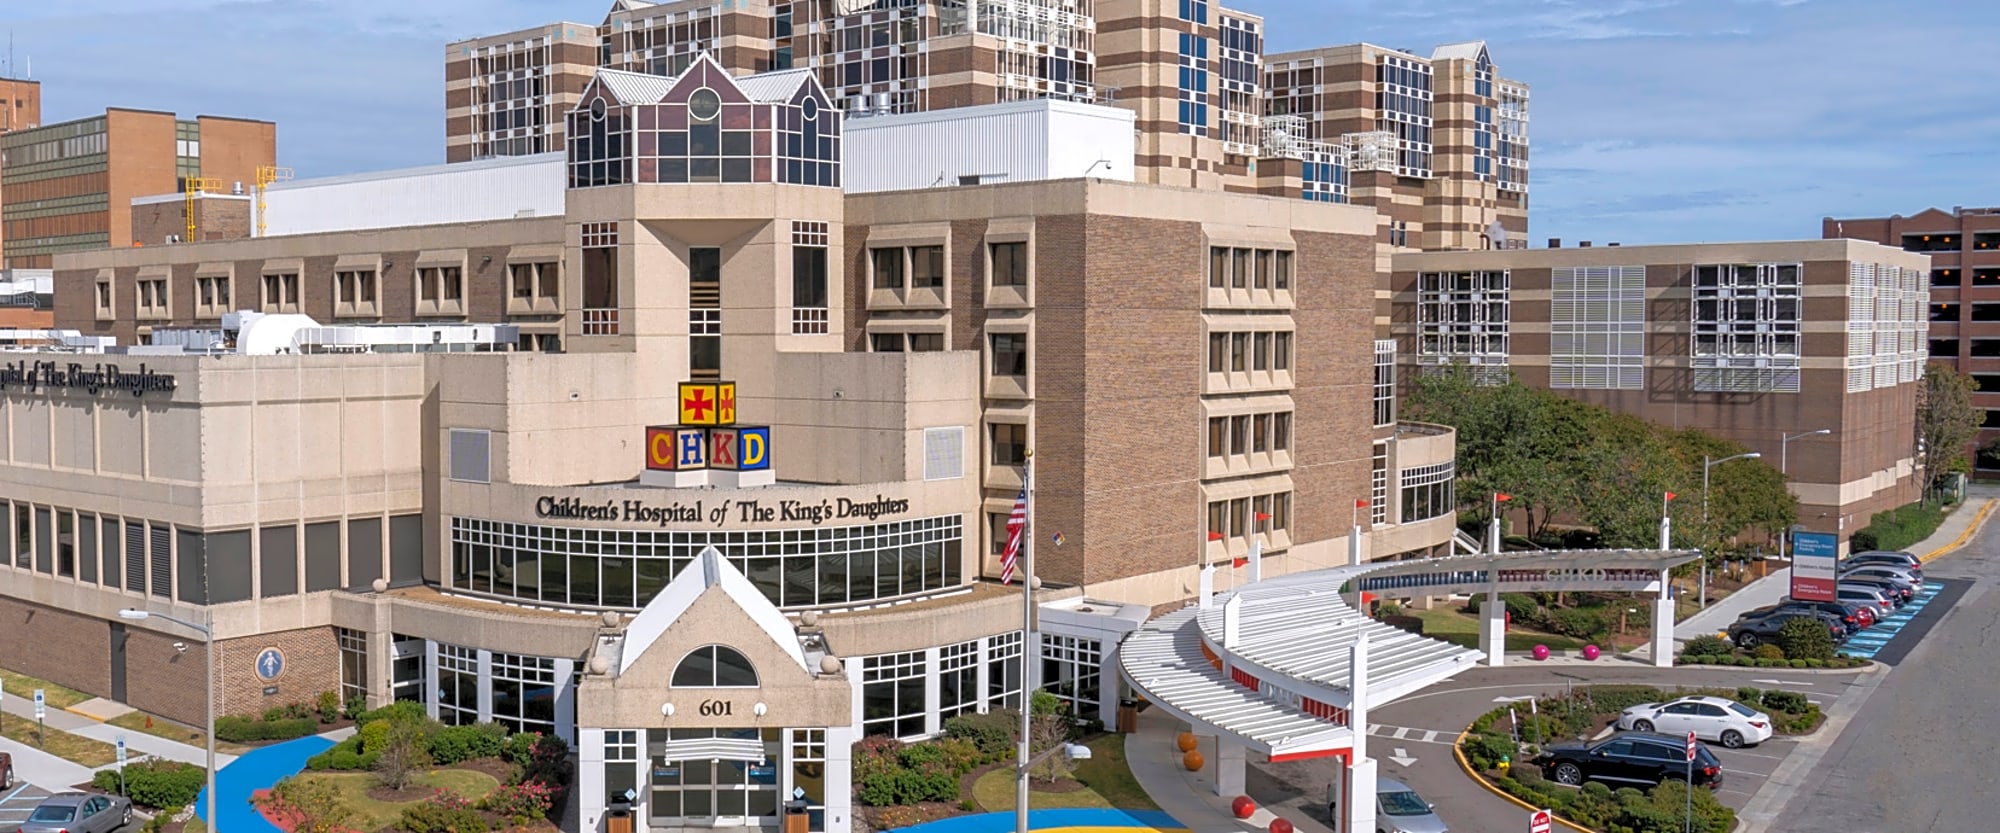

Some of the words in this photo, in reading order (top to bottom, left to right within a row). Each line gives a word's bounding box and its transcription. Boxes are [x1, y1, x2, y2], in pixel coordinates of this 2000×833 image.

[27, 360, 40, 392] of
[41, 361, 66, 388] The
[67, 362, 104, 395] King's
[106, 363, 175, 397] Daughters
[651, 432, 765, 466] CHKD
[536, 496, 618, 520] Children's
[622, 500, 703, 527] Hospital
[710, 500, 730, 527] of
[737, 501, 774, 523] The
[780, 500, 832, 525] King's
[836, 494, 909, 521] Daughters
[699, 699, 732, 716] 601
